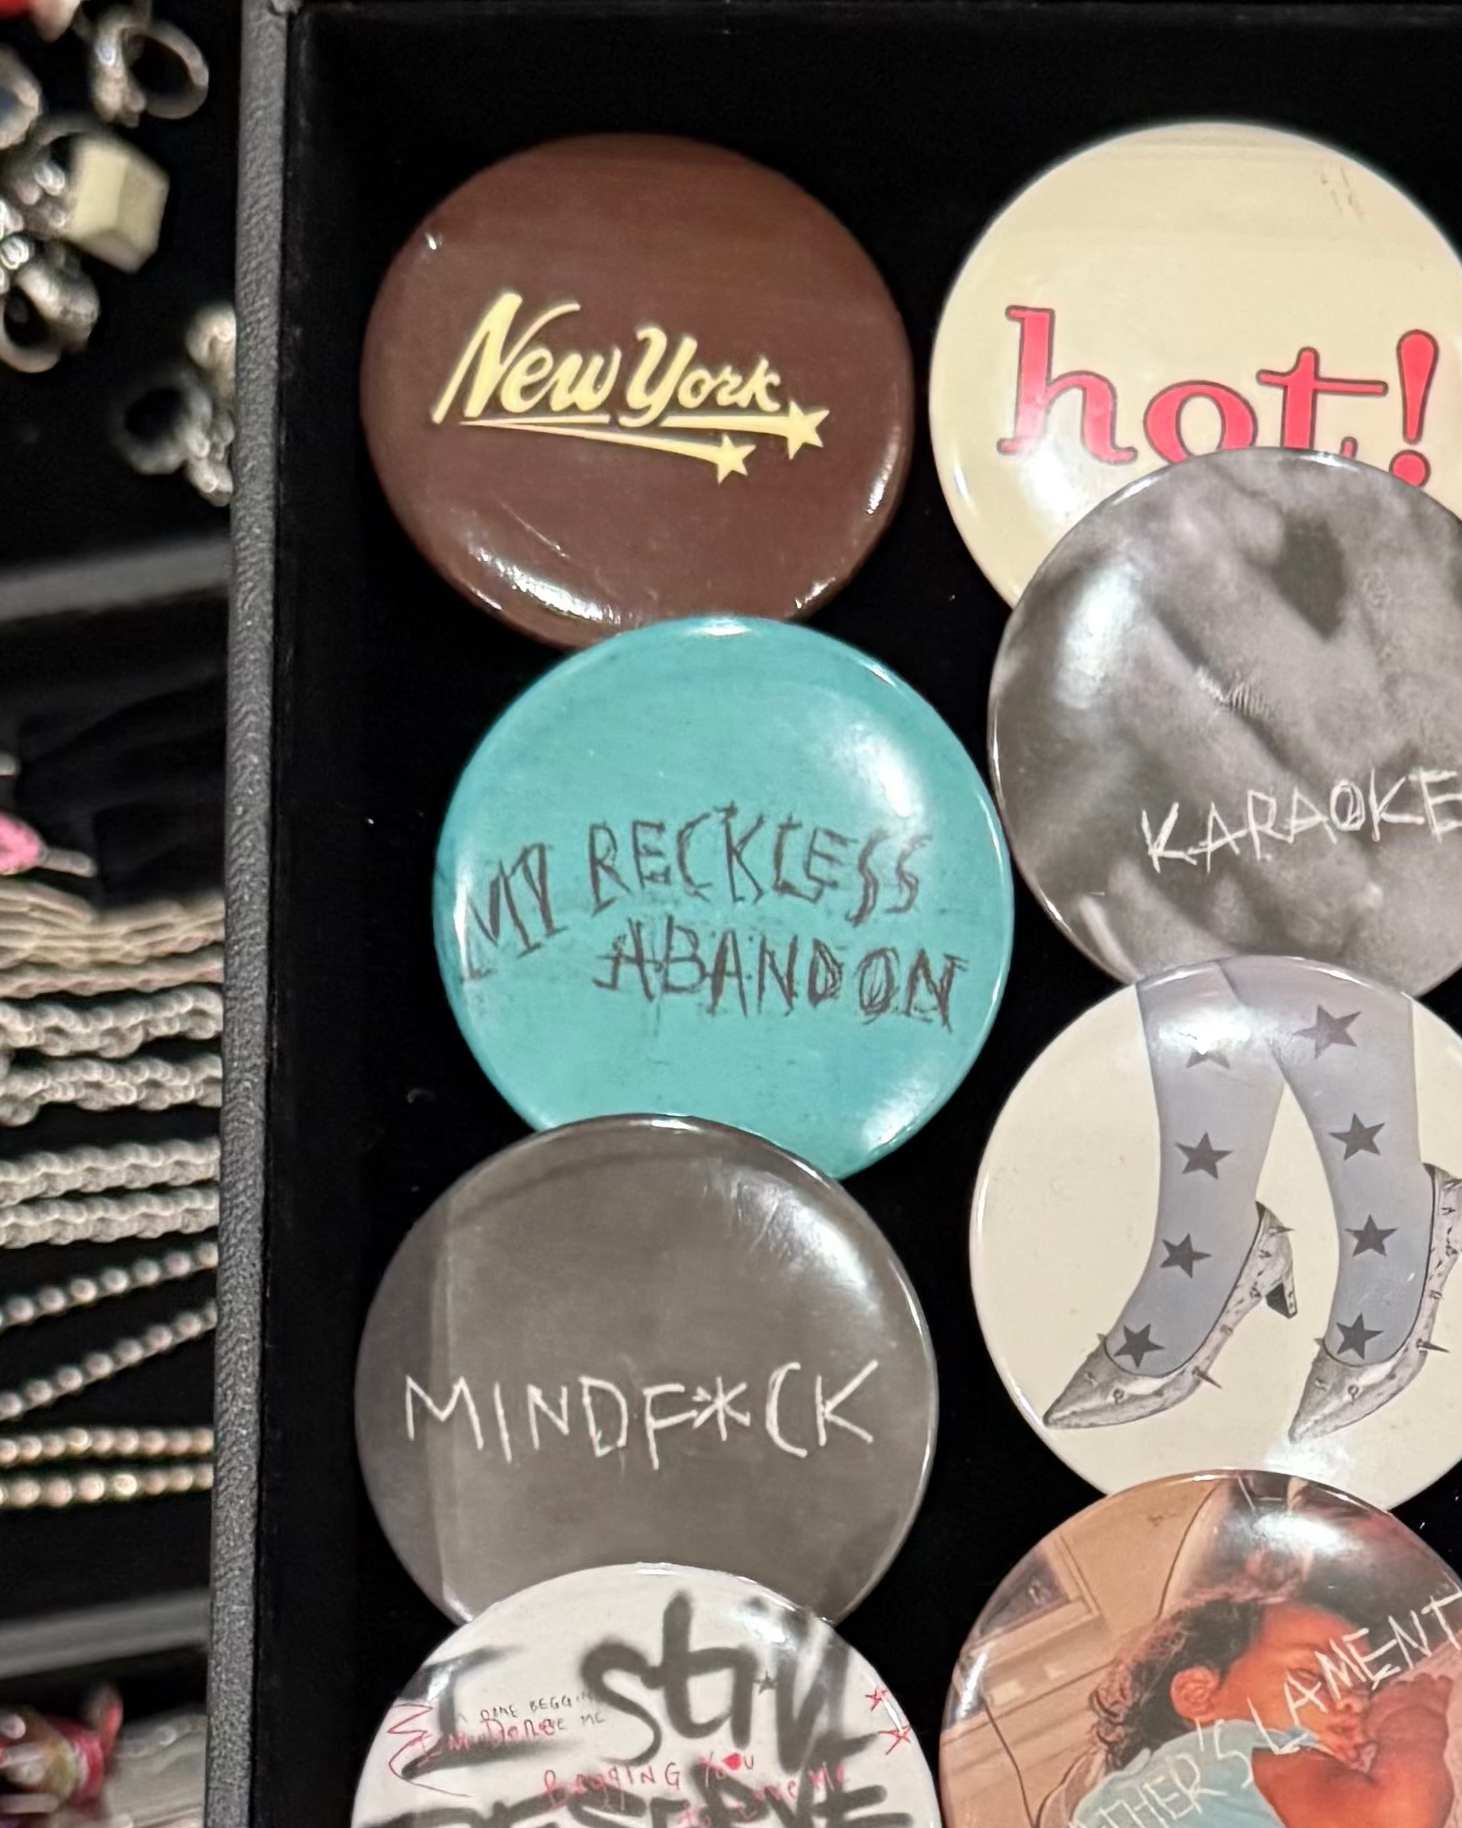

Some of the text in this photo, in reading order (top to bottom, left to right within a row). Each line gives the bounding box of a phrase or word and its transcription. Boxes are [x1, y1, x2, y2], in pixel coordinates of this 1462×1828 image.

[431, 293, 786, 427] New York
[997, 304, 1439, 488] hot!
[586, 800, 932, 928] RECKLESS
[592, 913, 968, 1032] ABANDON
